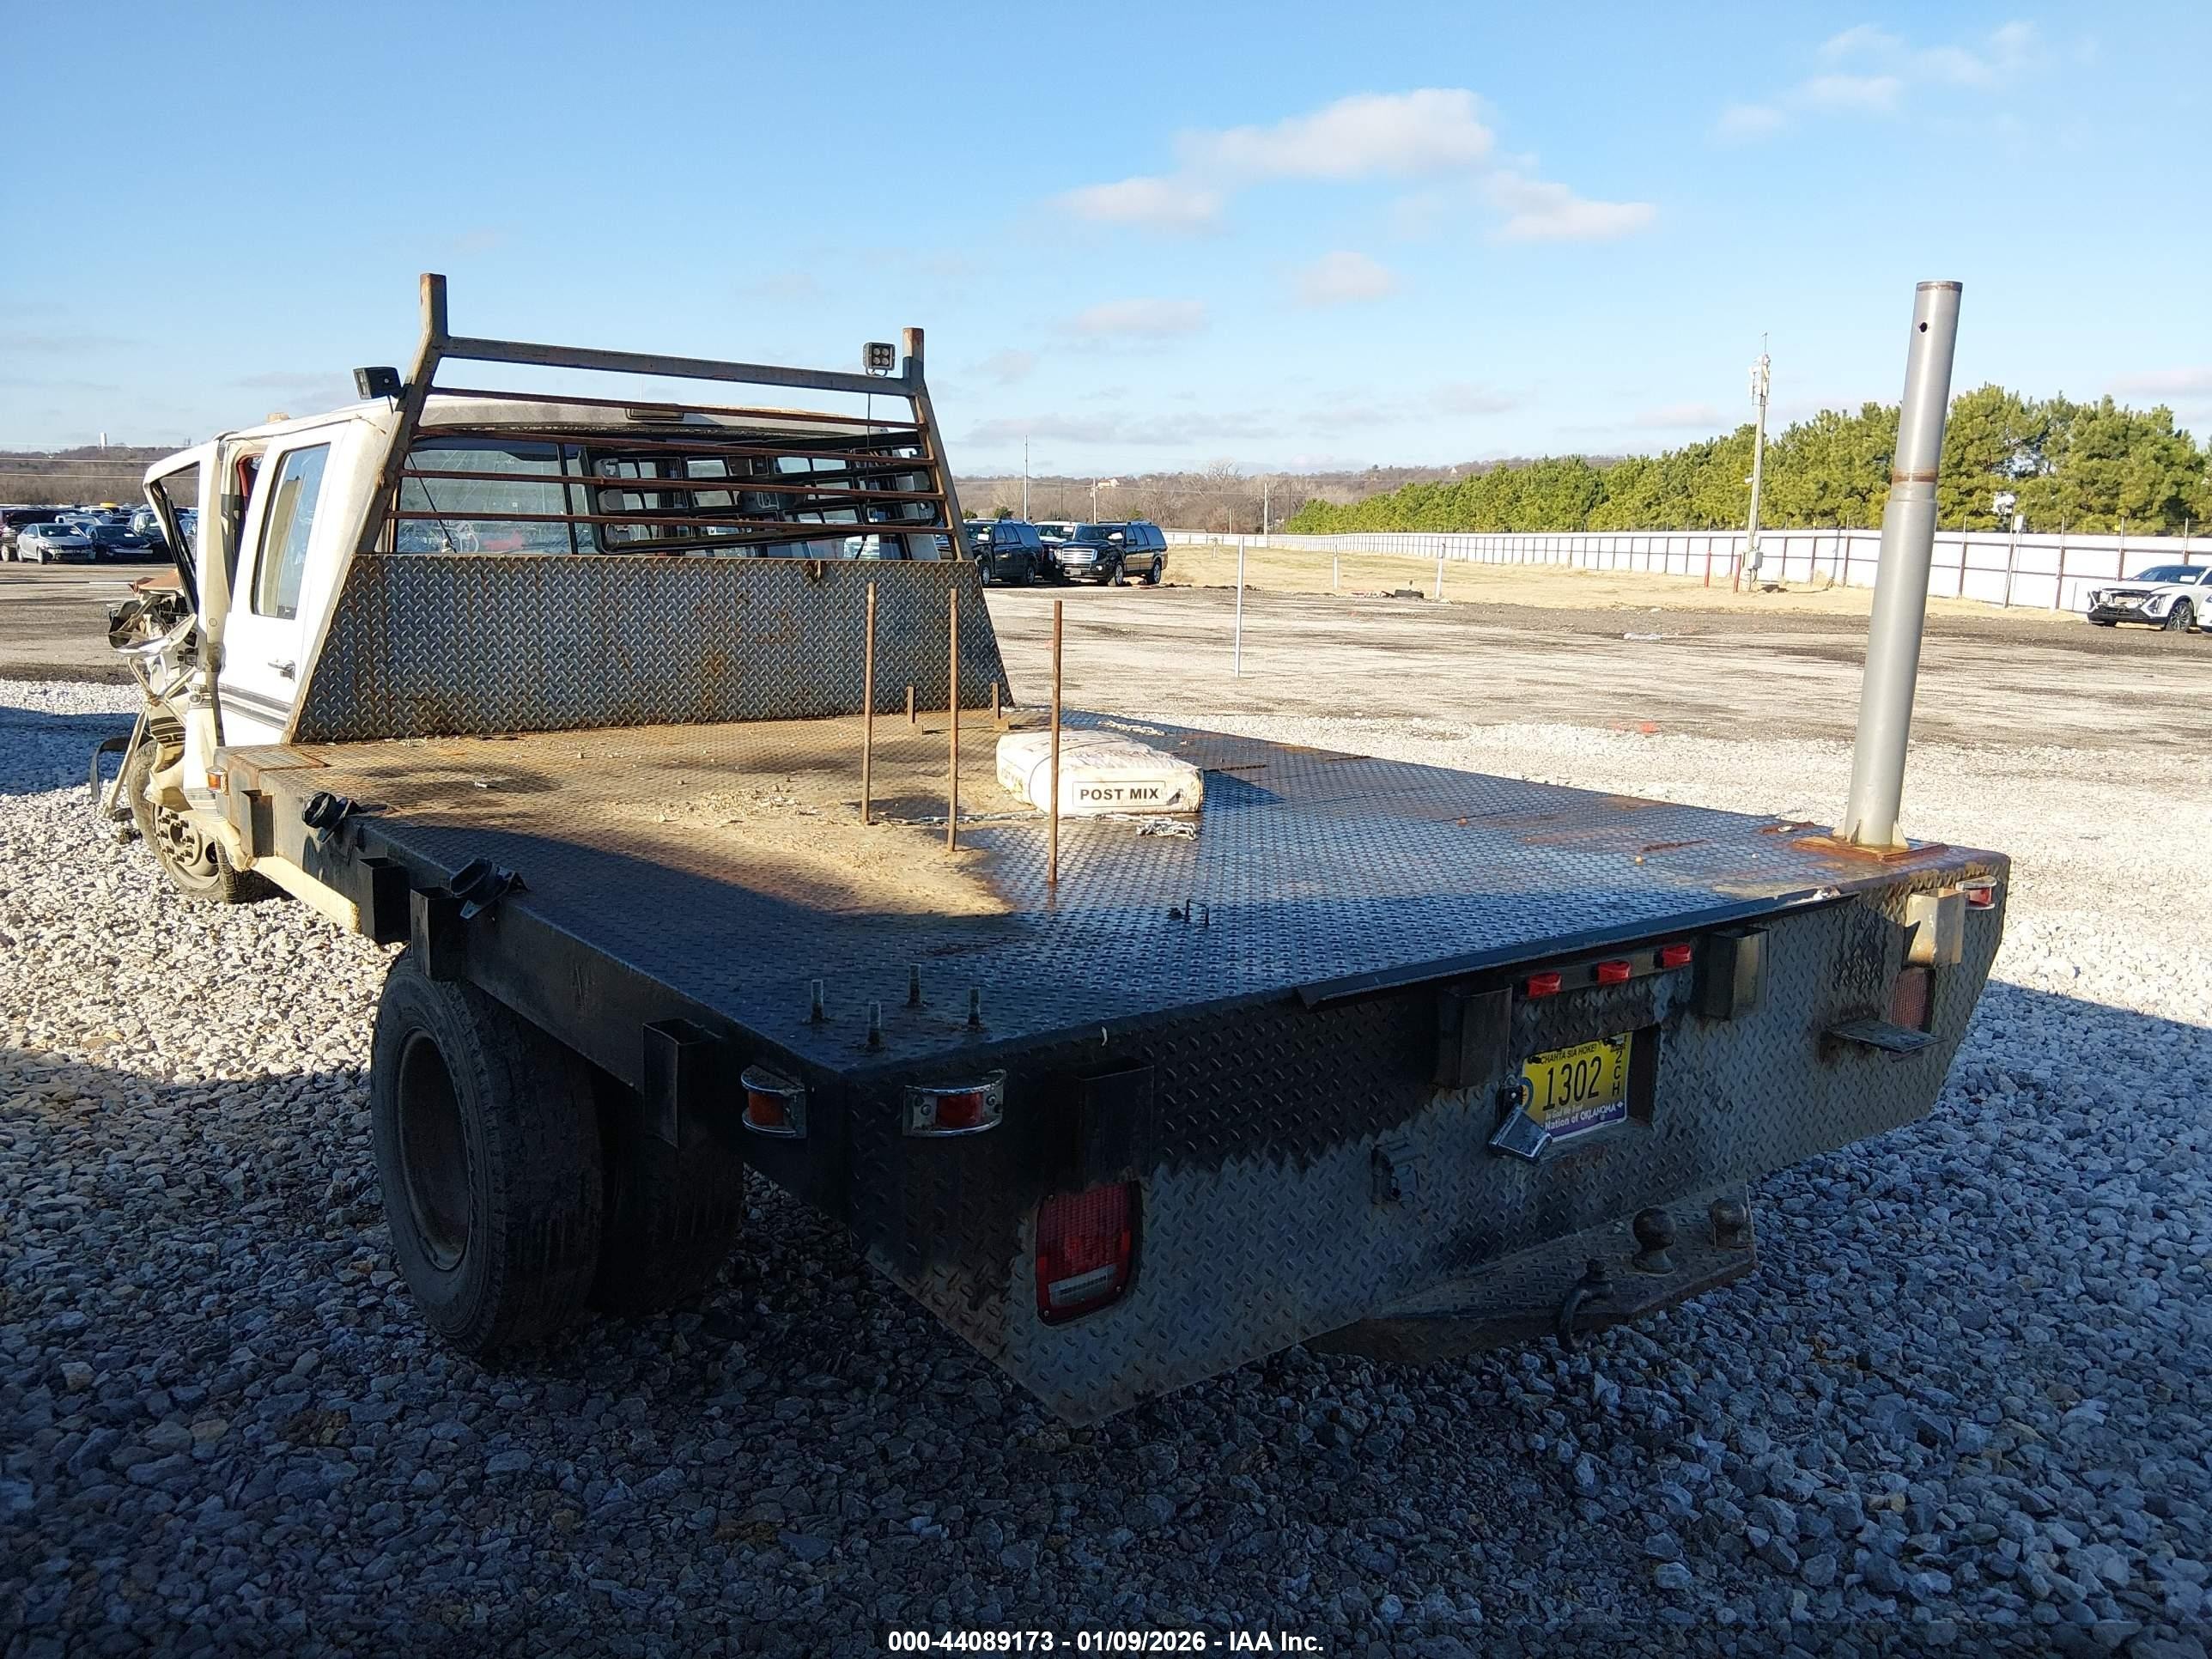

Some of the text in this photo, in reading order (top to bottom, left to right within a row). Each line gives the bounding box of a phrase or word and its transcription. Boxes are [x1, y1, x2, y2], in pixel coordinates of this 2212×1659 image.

[1080, 788, 1159, 799] POST MIX
[1542, 1055, 1601, 1111] 1302
[1545, 1118, 1570, 1131] Nation
[1571, 1114, 1579, 1124] of
